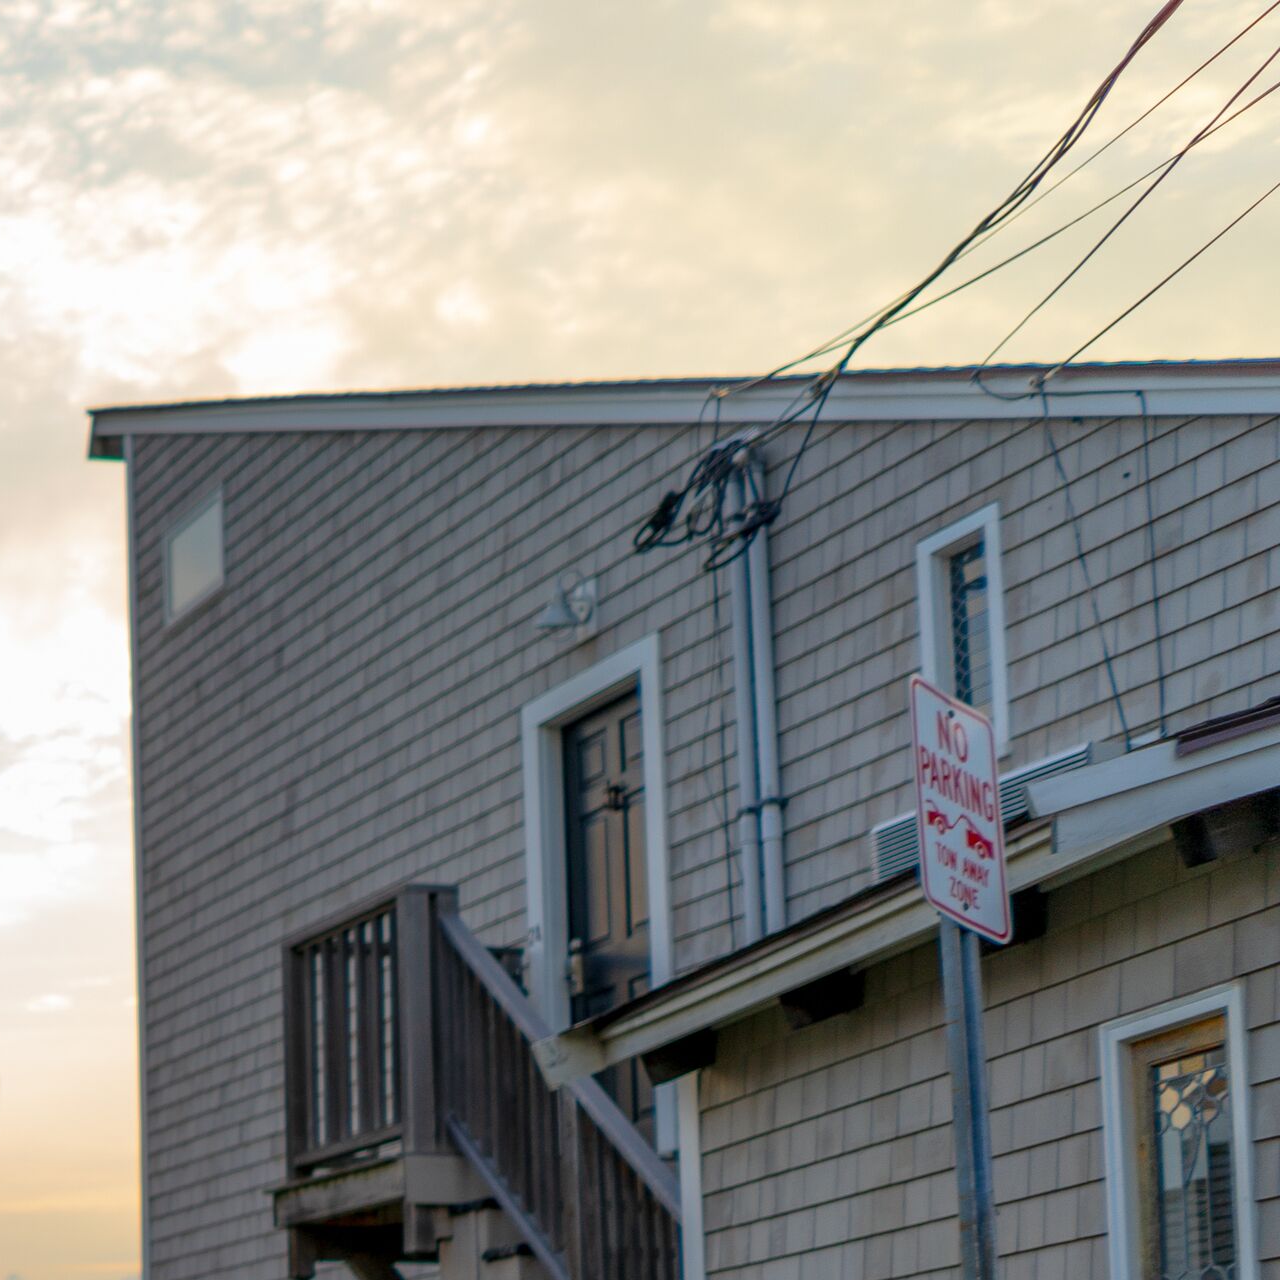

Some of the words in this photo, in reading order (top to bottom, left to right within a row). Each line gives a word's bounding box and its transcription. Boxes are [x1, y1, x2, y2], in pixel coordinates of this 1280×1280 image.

[936, 709, 968, 763] NO
[920, 745, 994, 823] PARKING
[935, 841, 958, 871] TOW
[962, 857, 991, 888] AWAY
[949, 875, 980, 910] ZONE
